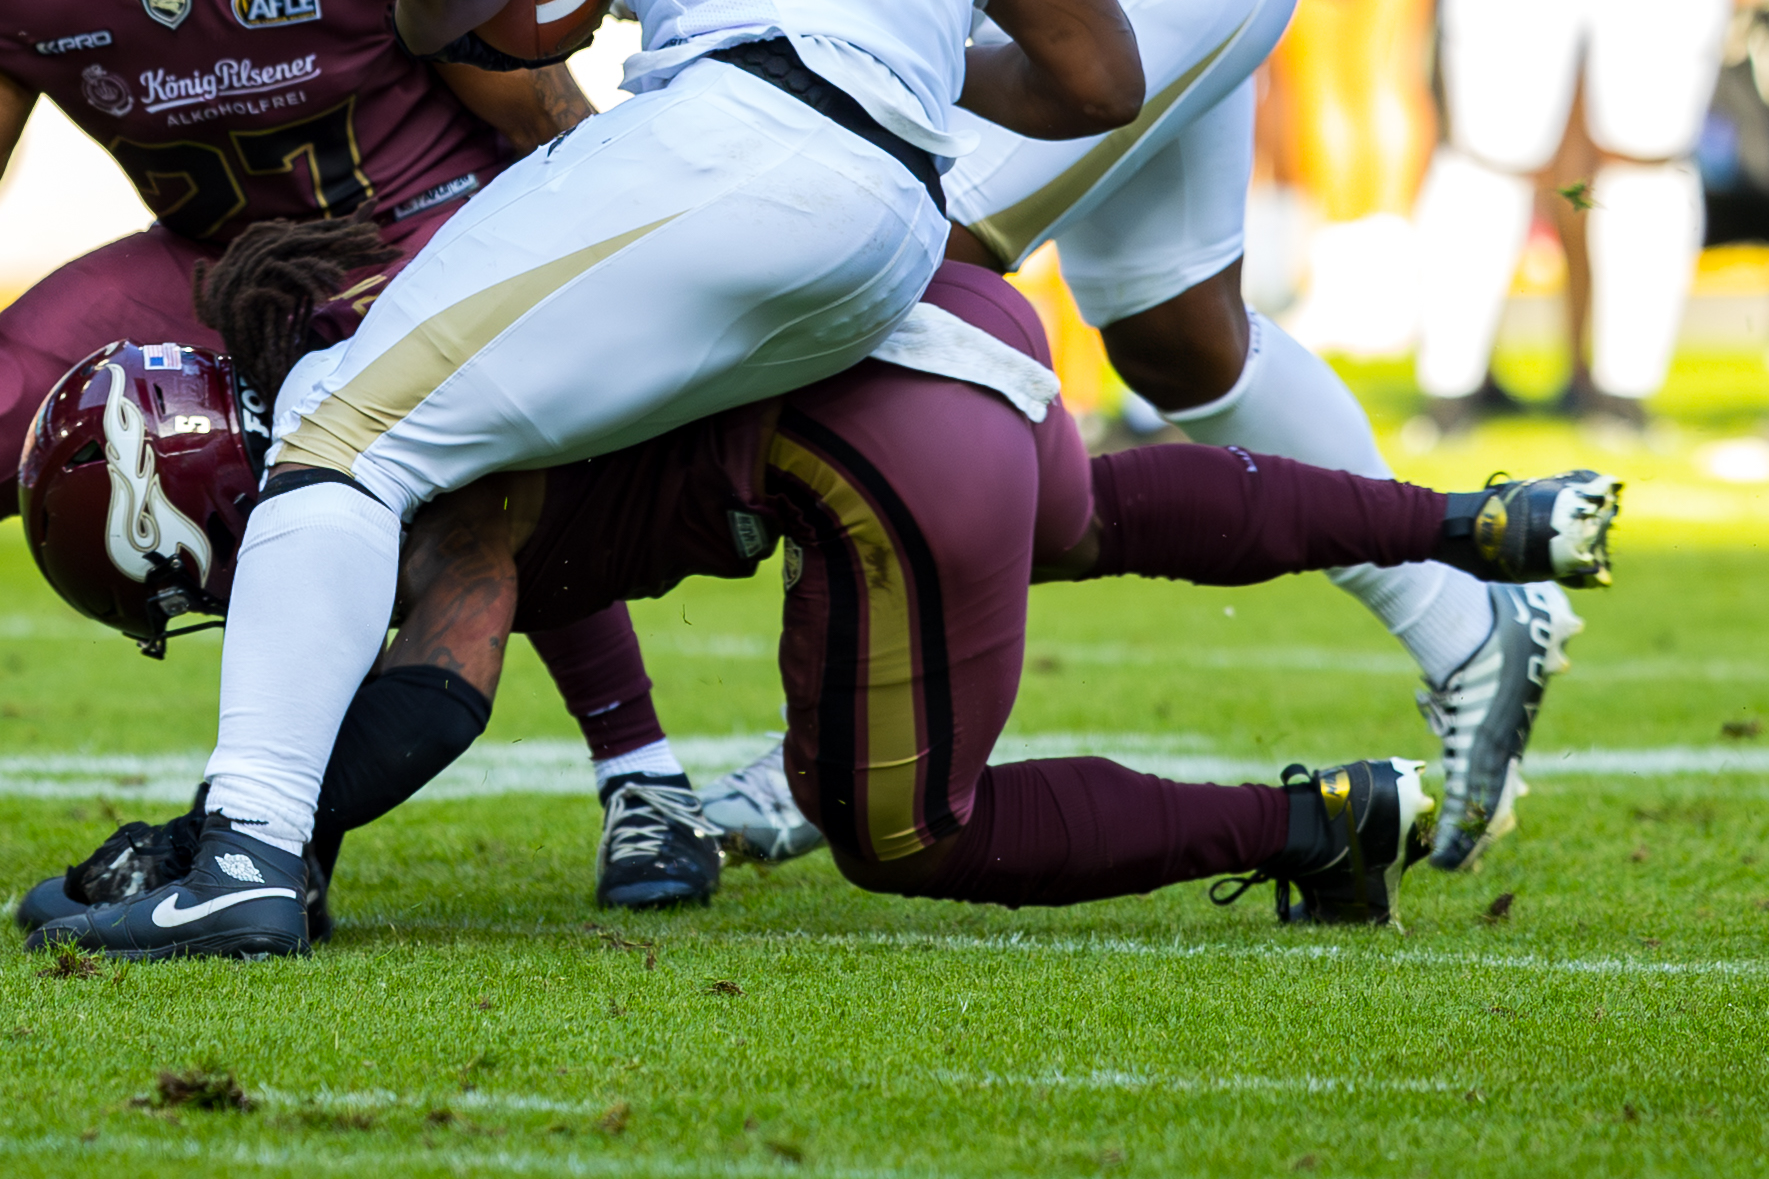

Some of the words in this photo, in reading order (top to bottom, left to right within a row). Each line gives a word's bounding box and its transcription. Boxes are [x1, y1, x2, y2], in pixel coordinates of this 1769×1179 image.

[166, 90, 309, 127] ALKOHOLFREI
[104, 94, 376, 238] 27
[174, 415, 211, 434] 5
